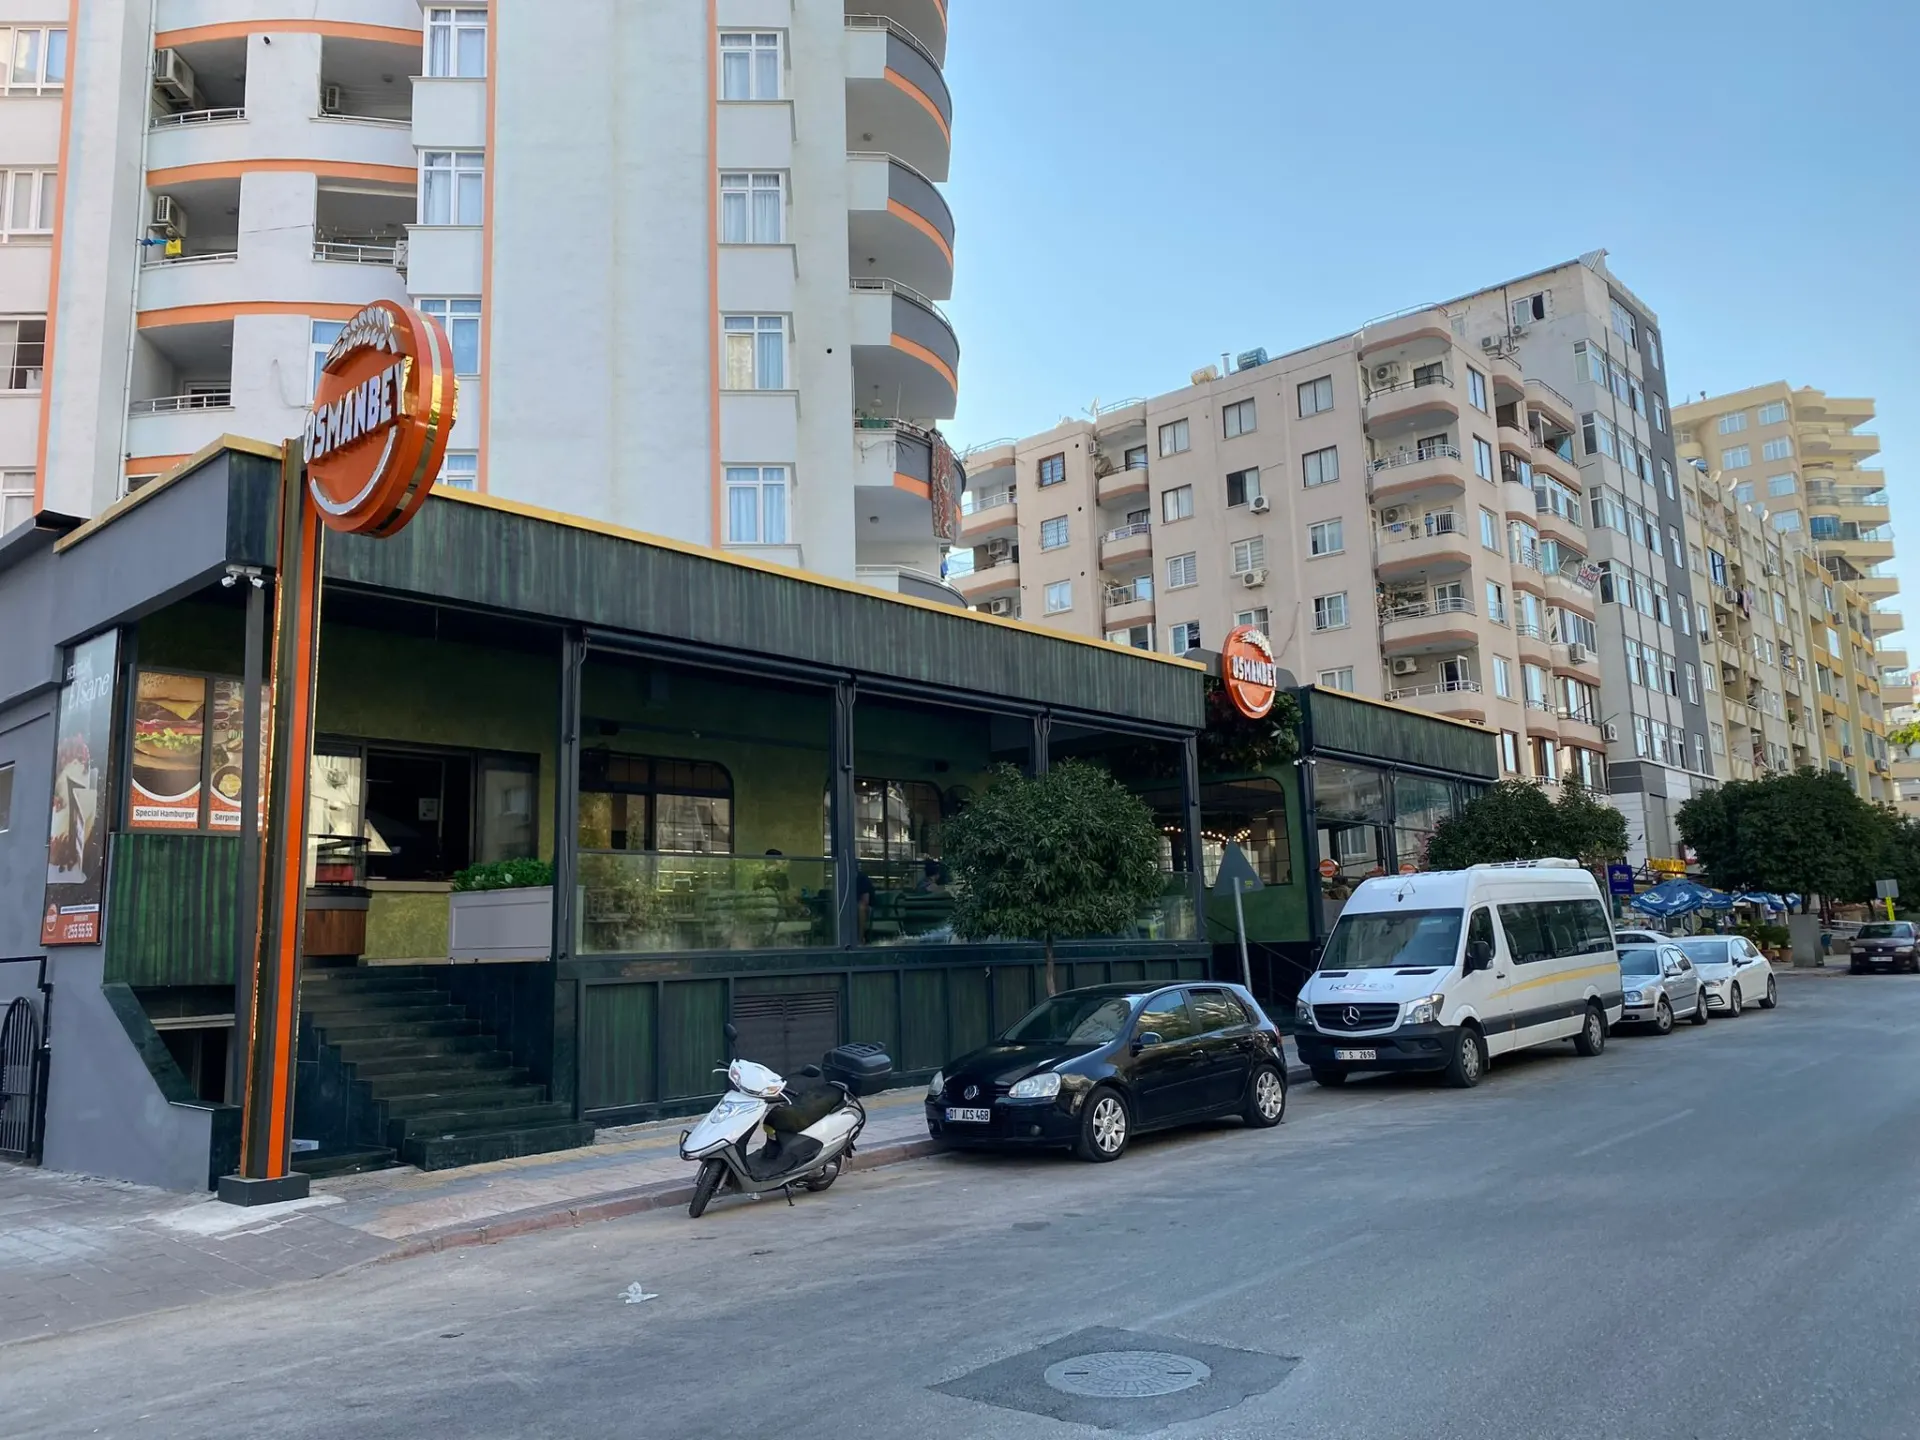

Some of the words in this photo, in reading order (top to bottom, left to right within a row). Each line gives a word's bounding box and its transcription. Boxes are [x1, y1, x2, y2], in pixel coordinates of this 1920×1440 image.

[303, 357, 407, 463] OSMANBEY
[1232, 655, 1277, 687] OSMANBEY
[135, 808, 159, 818] Special
[160, 810, 195, 820] Hamburger
[214, 812, 239, 822] Serpme
[950, 1109, 957, 1119] 01
[962, 1109, 974, 1120] ACS
